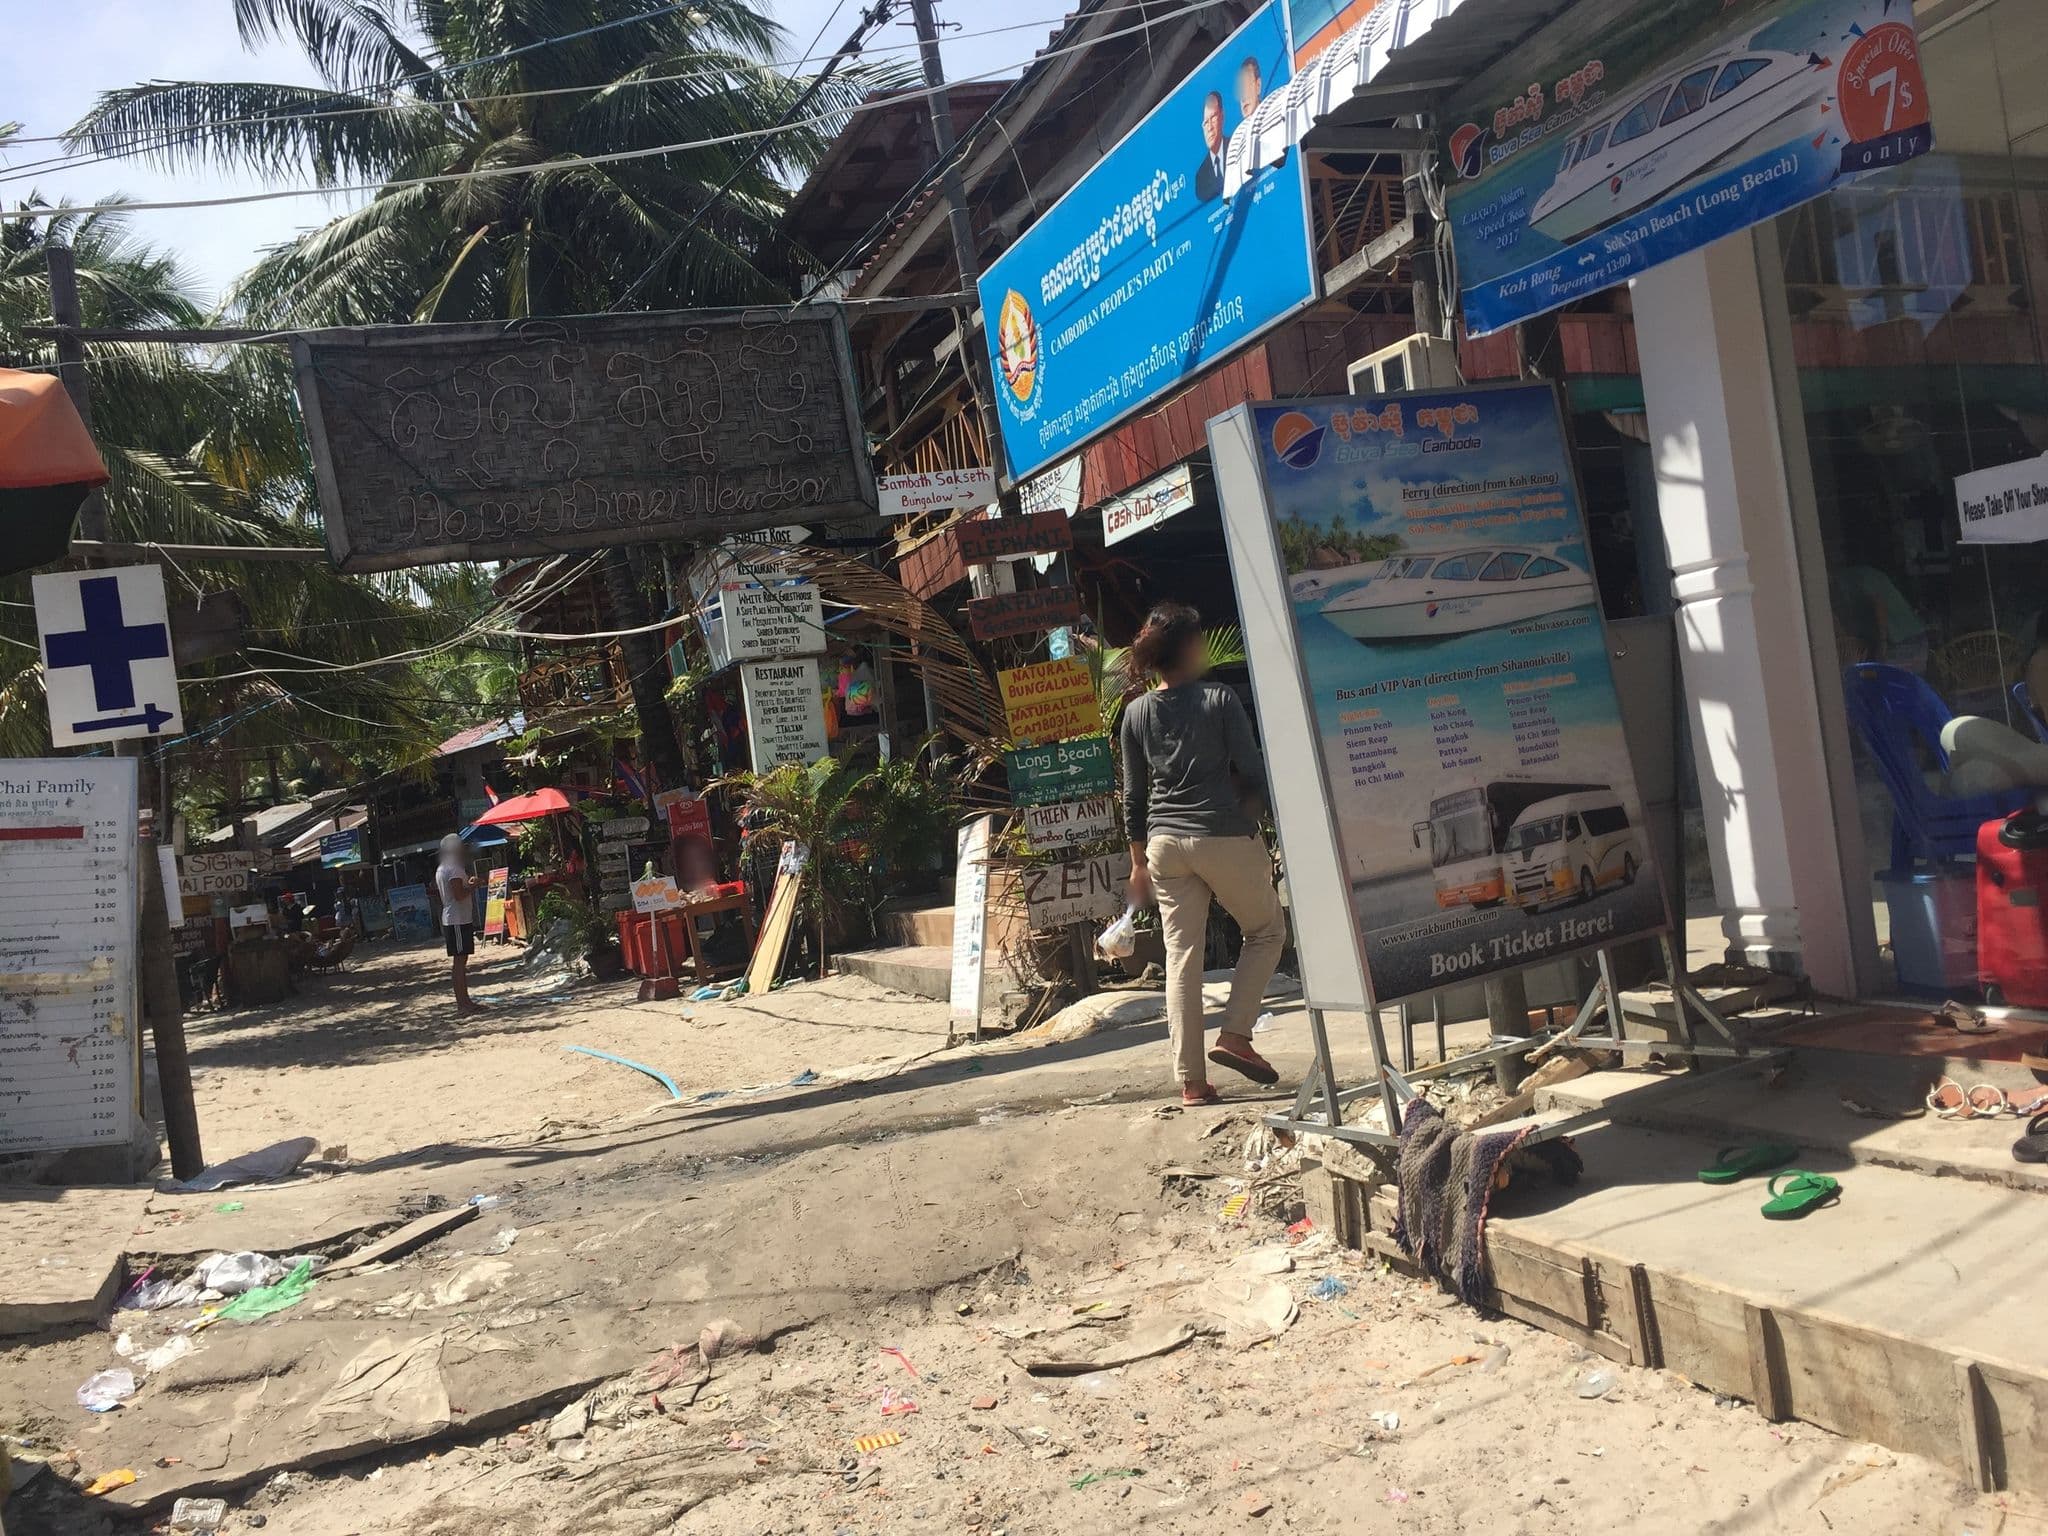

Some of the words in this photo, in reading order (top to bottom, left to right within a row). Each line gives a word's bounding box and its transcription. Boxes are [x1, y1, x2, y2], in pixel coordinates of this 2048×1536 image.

[1847, 37, 1883, 89] Special
[1888, 31, 1915, 61] Offer
[1489, 137, 1518, 165] Buva
[1519, 125, 1543, 147] Sea
[1863, 136, 1918, 163] only
[1500, 279, 1527, 298] Koh
[1530, 265, 1561, 288] Rong
[1650, 206, 1692, 232] Beach
[1695, 185, 1740, 214] (Long
[1743, 154, 1799, 192] Beach)
[1496, 228, 1519, 250] 2017
[1550, 268, 1605, 296] Departure
[1606, 253, 1632, 274] 13:00
[1050, 308, 1100, 356] CAMBODIAN
[1099, 274, 1143, 320] PEOPLE'S
[1142, 246, 1176, 287] PARTY
[1422, 436, 1481, 454] Cambodia
[878, 471, 933, 492] Sambath
[938, 468, 991, 487] Sakseth
[1402, 488, 1430, 500] Ferry
[1432, 482, 1481, 498] (direction
[1482, 480, 1507, 494] from
[1509, 476, 1527, 488] Koh
[1530, 472, 1559, 487] Rong)
[400, 491, 543, 542] Happy
[536, 480, 684, 531] Khmer
[682, 474, 759, 516] New
[752, 461, 830, 507] Year
[901, 491, 953, 511] Bungalow
[1963, 499, 1986, 523] Please
[1985, 493, 2003, 517] Take
[2003, 489, 2015, 513] Off
[2014, 487, 2032, 511] Your
[1107, 505, 1132, 534] Cash
[769, 528, 792, 543] ROSE
[963, 528, 1066, 558] ELEPHANT
[736, 563, 780, 576] RESTAURANT
[738, 593, 761, 605] WHITE
[779, 590, 813, 602] GUESTHOUSE
[1509, 615, 1591, 636] www.buvasea.com
[792, 636, 801, 645] TV
[755, 666, 804, 680] RESTAURANT
[1012, 660, 1075, 683] NATURAL
[1336, 687, 1356, 702] Bus
[1358, 684, 1378, 698] and
[1380, 679, 1401, 693] VIP
[1402, 676, 1421, 689] Van
[1423, 668, 1474, 687] (direction
[1474, 665, 1500, 680] from
[1501, 651, 1571, 673] Sihanoukville)
[1008, 672, 1089, 698] BUNGALOWS
[1011, 700, 1069, 723] NATURAL
[1430, 711, 1445, 721] Koh
[776, 724, 803, 735] ITALIAN
[1343, 725, 1371, 737] Phnom
[1374, 720, 1393, 732] Penh
[1433, 723, 1448, 733] Koh
[1450, 718, 1474, 731] Chang
[1515, 734, 1526, 743] Ho
[1527, 731, 1540, 741] Chi
[1541, 727, 1560, 738] Minh
[1346, 739, 1366, 750] Siem
[1368, 734, 1389, 747] Reap
[1436, 732, 1469, 745] Bangkok
[775, 751, 805, 761] MEXICAN
[1014, 754, 1050, 770] Long
[1058, 743, 1102, 763] Beach
[1349, 745, 1398, 762] Battambang
[1438, 745, 1468, 758] Pattaya
[1351, 761, 1387, 775] Bangkok
[1442, 760, 1459, 770] Koh
[1460, 755, 1483, 767] Samet
[36, 779, 96, 795] Family
[1354, 778, 1365, 787] Ho
[1367, 774, 1382, 785] Chi
[1383, 770, 1405, 782] Minh
[1031, 806, 1069, 826] THIEN
[1076, 801, 1107, 820] ANN
[1028, 833, 1063, 845] Bamboo
[1064, 829, 1090, 845] Guest
[203, 874, 244, 891] FOOD
[1024, 861, 1111, 905] ZEN
[1041, 903, 1094, 925] Bungalows
[1379, 910, 1498, 948] www.virakbuntham.com
[1430, 942, 1486, 977] Book
[1489, 926, 1554, 959] Ticket
[1560, 909, 1616, 945] Here!
